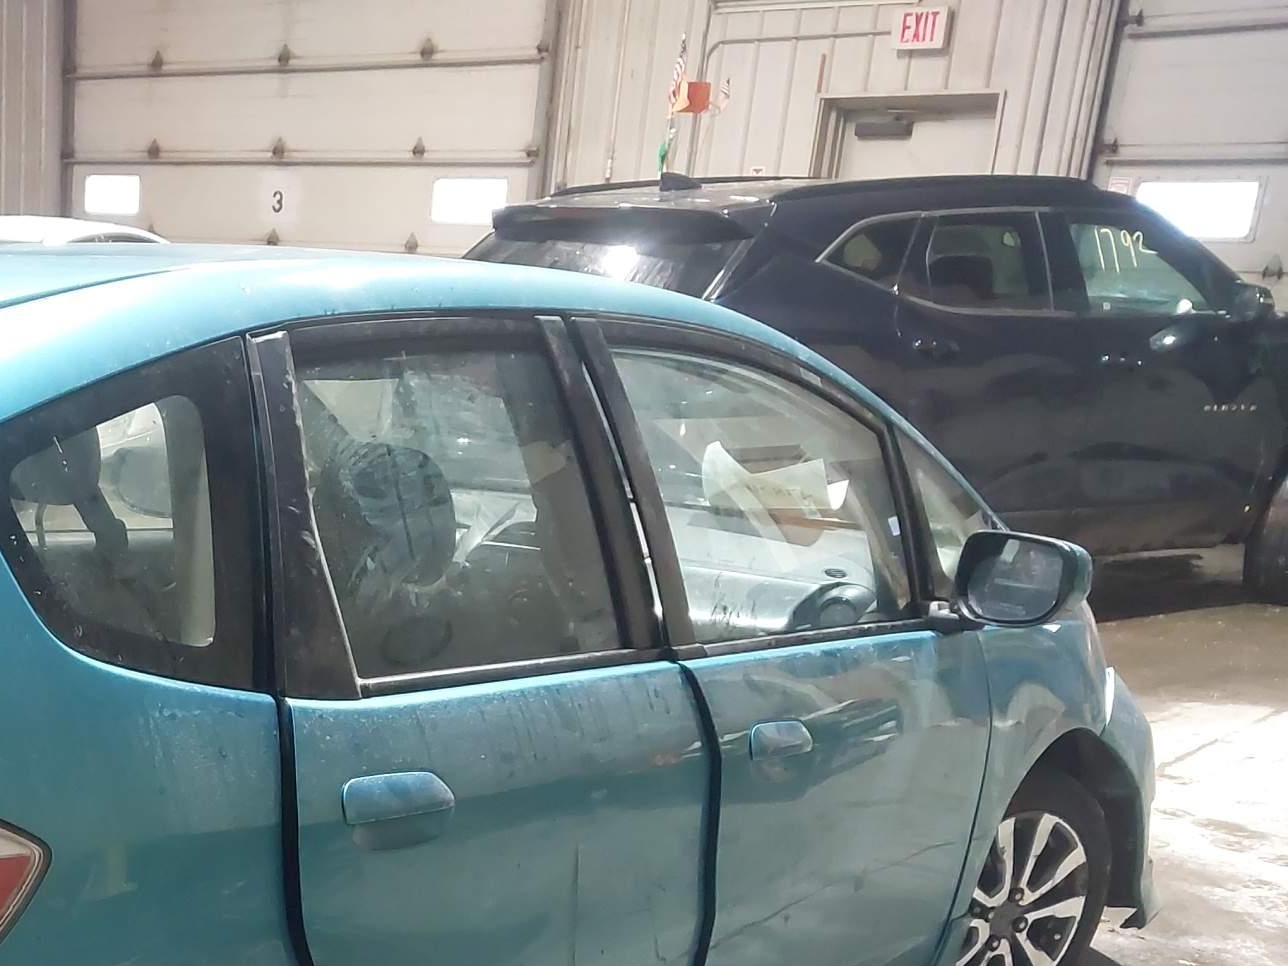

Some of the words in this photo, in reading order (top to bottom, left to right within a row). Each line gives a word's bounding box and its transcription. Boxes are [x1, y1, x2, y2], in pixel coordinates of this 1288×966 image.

[900, 11, 940, 44] EXIT
[272, 190, 283, 213] 3
[1094, 216, 1158, 273] 1792
